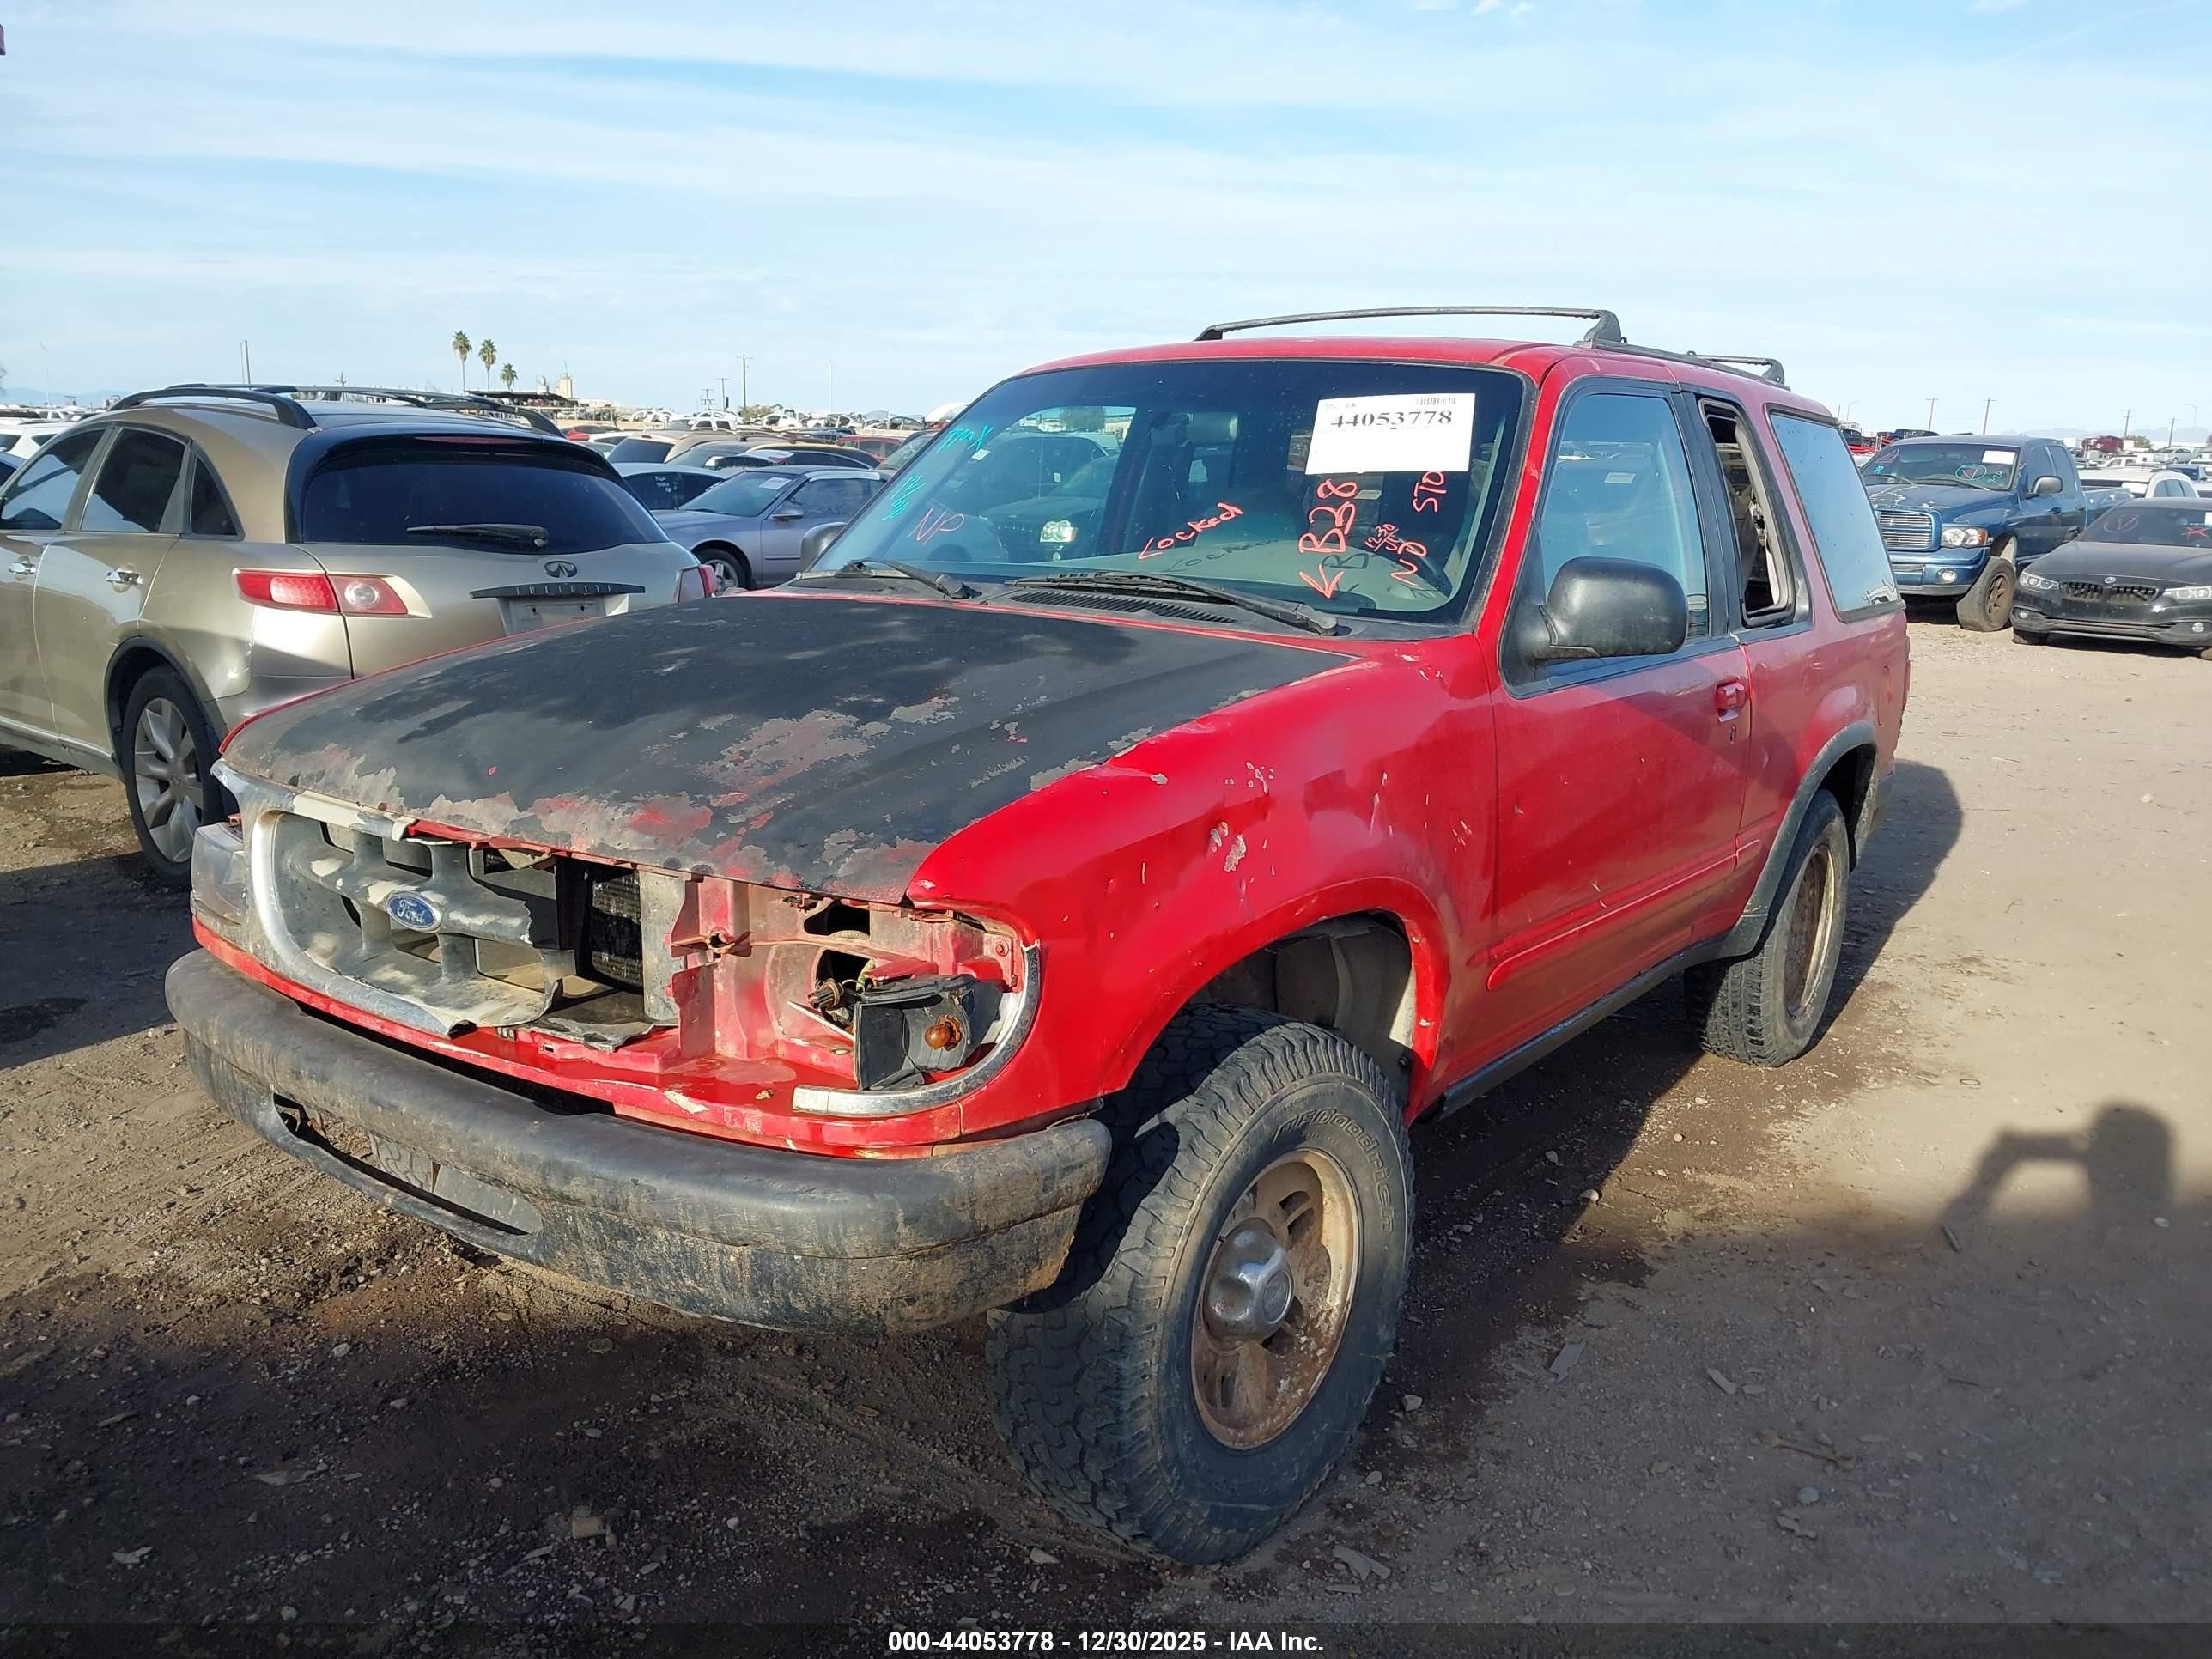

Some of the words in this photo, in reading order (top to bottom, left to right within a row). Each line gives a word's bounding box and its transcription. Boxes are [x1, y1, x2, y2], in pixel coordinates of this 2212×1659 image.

[1331, 410, 1453, 428] 44053778
[1138, 502, 1244, 560] Locked
[397, 899, 427, 923] Ford
